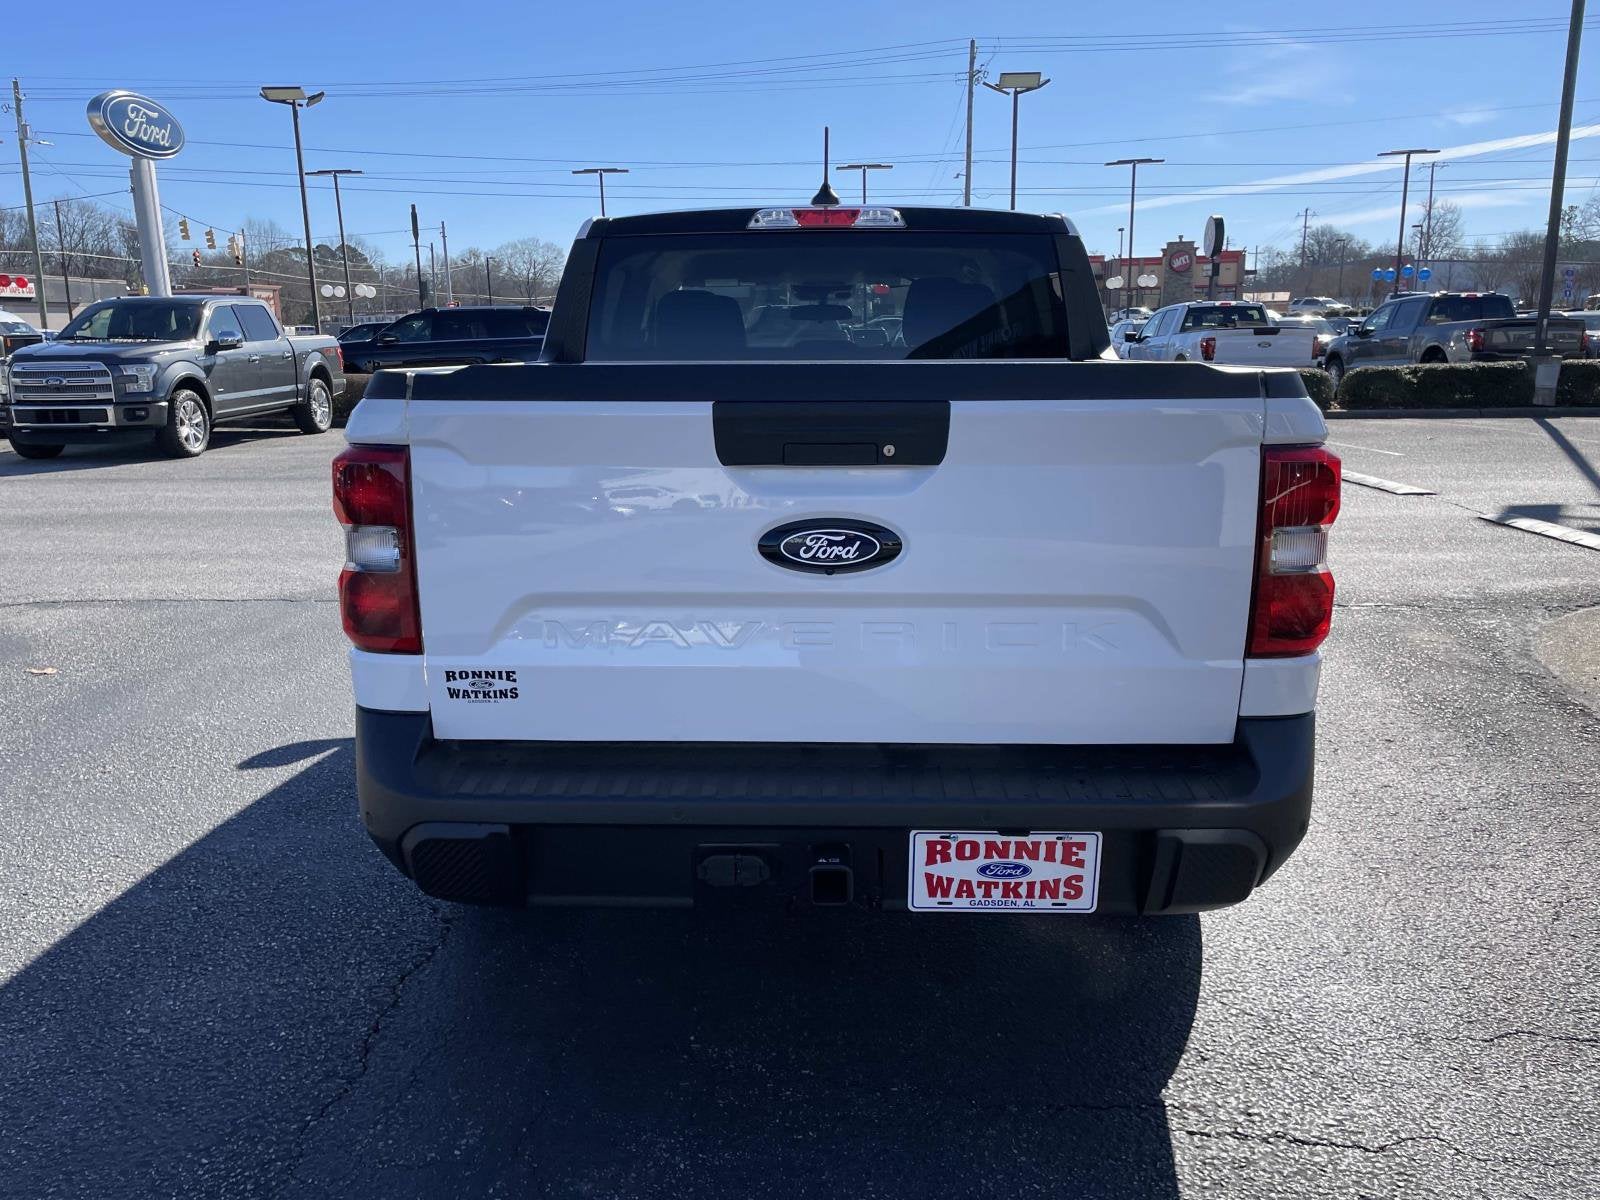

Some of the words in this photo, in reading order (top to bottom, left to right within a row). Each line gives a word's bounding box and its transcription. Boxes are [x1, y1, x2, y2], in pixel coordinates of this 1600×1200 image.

[125, 103, 171, 146] Ford
[800, 534, 861, 559] Ford
[543, 620, 1121, 650] MAVERICK
[445, 670, 517, 683] RONNIE
[447, 687, 519, 699] WATKINS
[925, 840, 1087, 869] RONNIE
[985, 864, 1024, 877] Ford
[924, 872, 1084, 900] WATKINS
[969, 900, 1020, 908] GADSDEN,
[1023, 900, 1036, 908] AL
